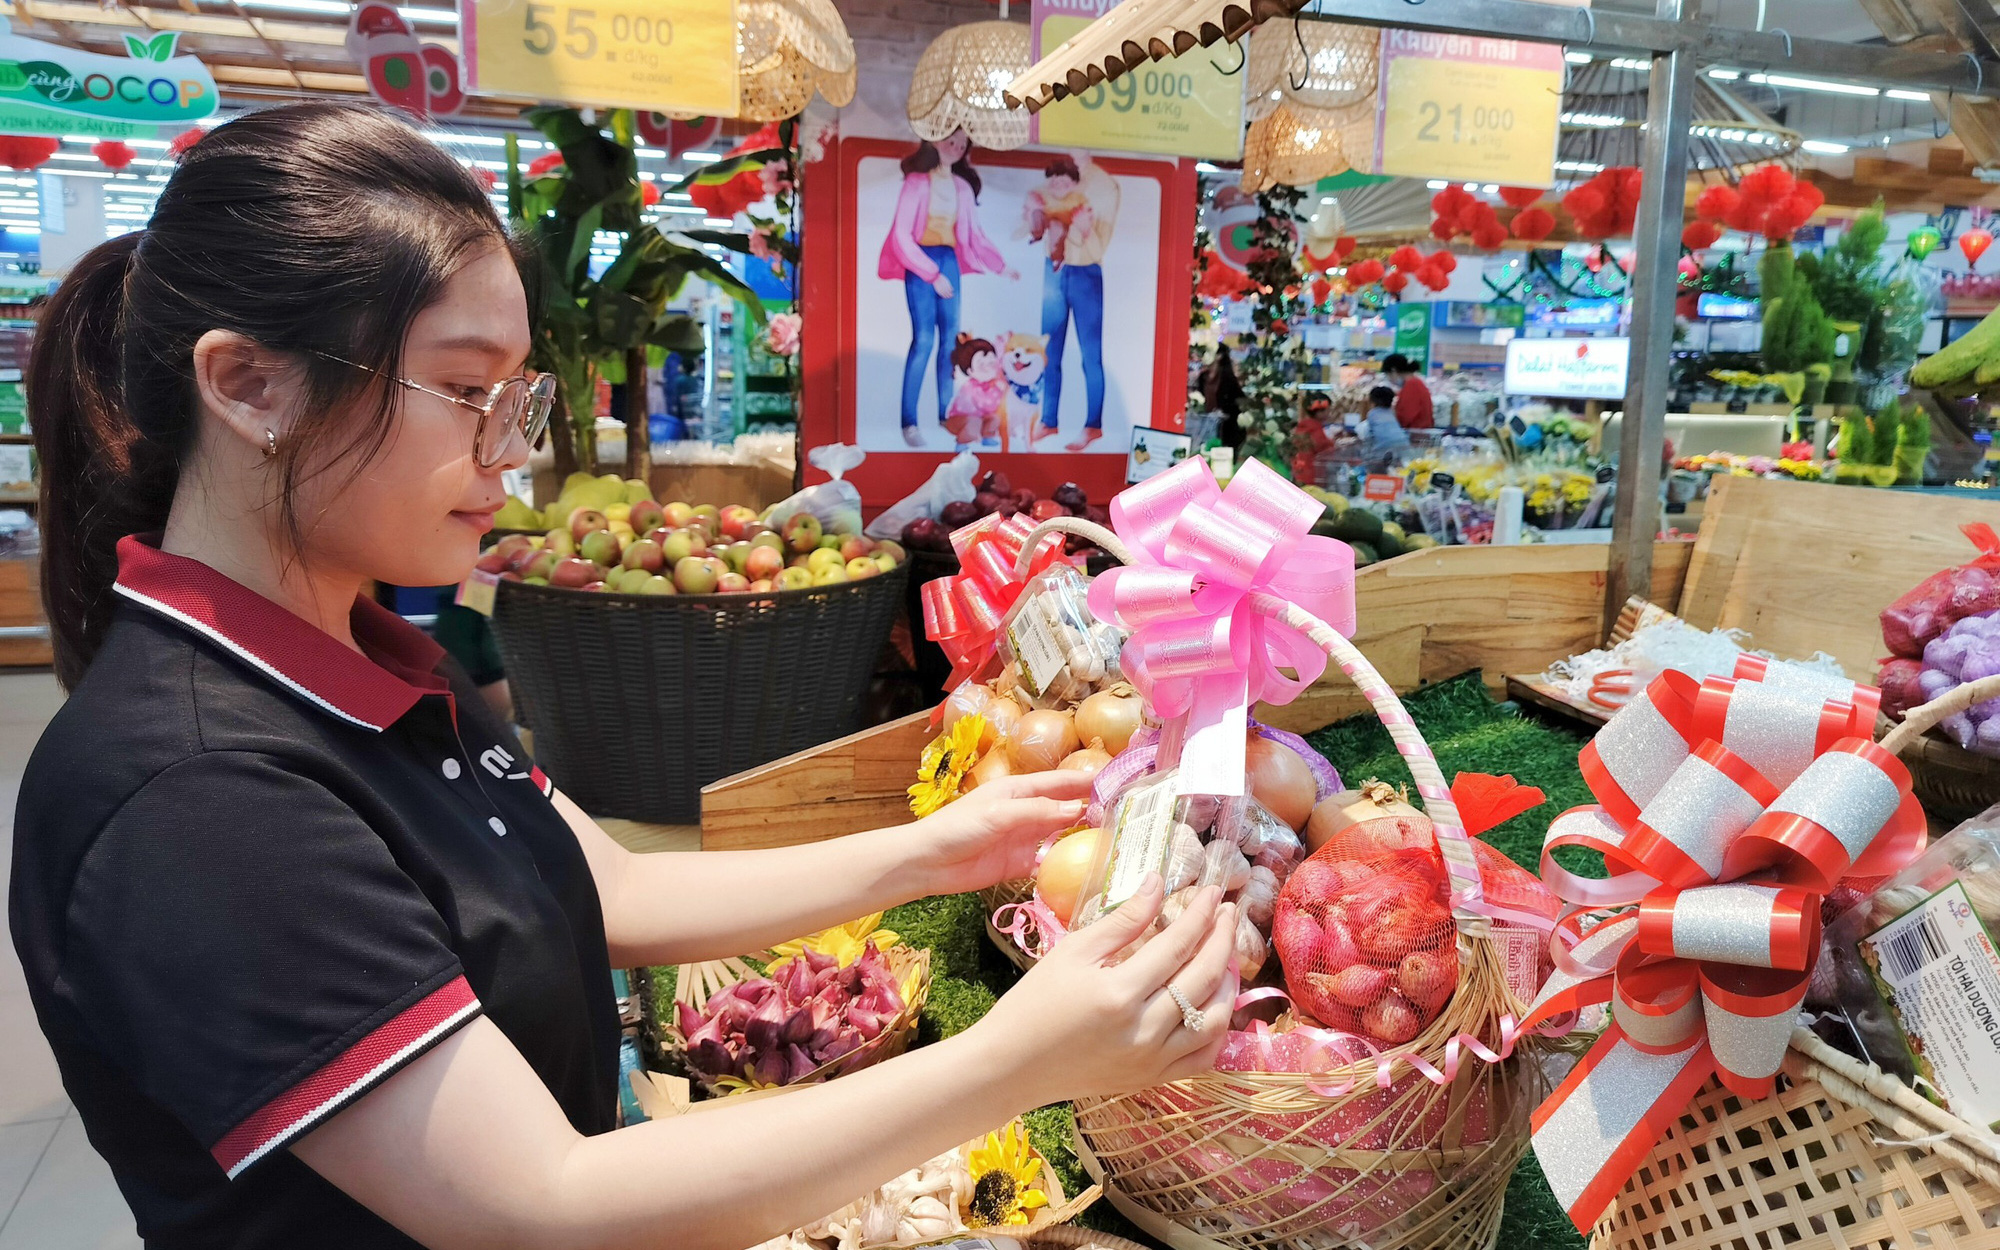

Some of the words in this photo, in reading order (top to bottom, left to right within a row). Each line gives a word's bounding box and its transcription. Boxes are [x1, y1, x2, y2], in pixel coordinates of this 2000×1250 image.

[28, 70, 78, 102] cùng
[84, 73, 203, 107] OCOP
[1975, 930, 1993, 954] CÔNG
[1988, 953, 1999, 966] TY
[1947, 952, 1970, 975] TỎI
[1956, 969, 1980, 993] HẢI
[1962, 1001, 1977, 1020] 100%
[1966, 989, 1999, 1033] DƯƠNG
